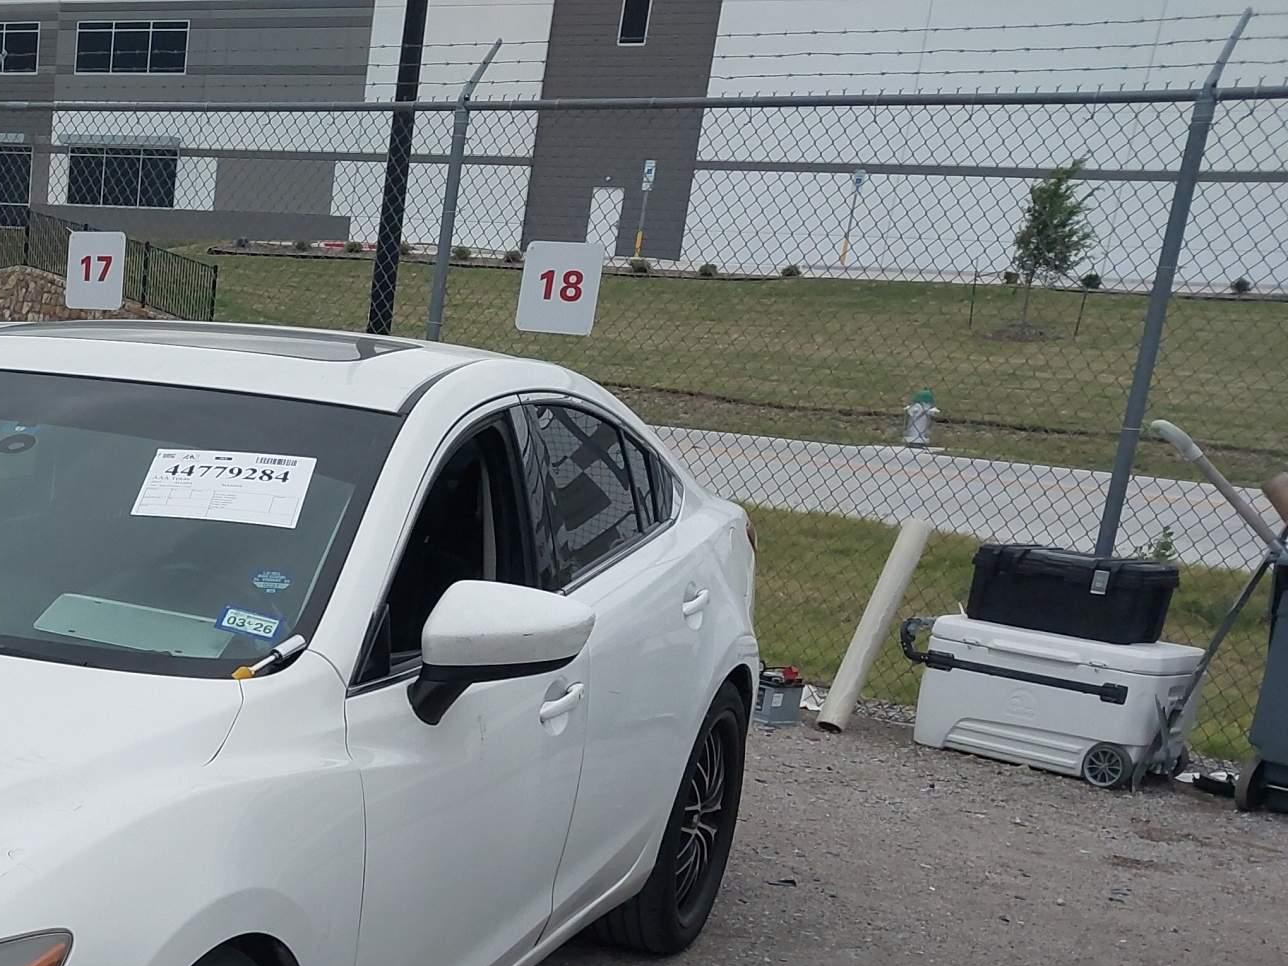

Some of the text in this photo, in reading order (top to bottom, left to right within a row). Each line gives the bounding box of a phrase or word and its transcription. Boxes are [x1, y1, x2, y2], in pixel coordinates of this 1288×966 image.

[80, 255, 113, 282] 17
[540, 269, 584, 302] 18
[164, 463, 290, 483] 44779284
[226, 615, 247, 628] 03
[253, 622, 273, 635] 26
